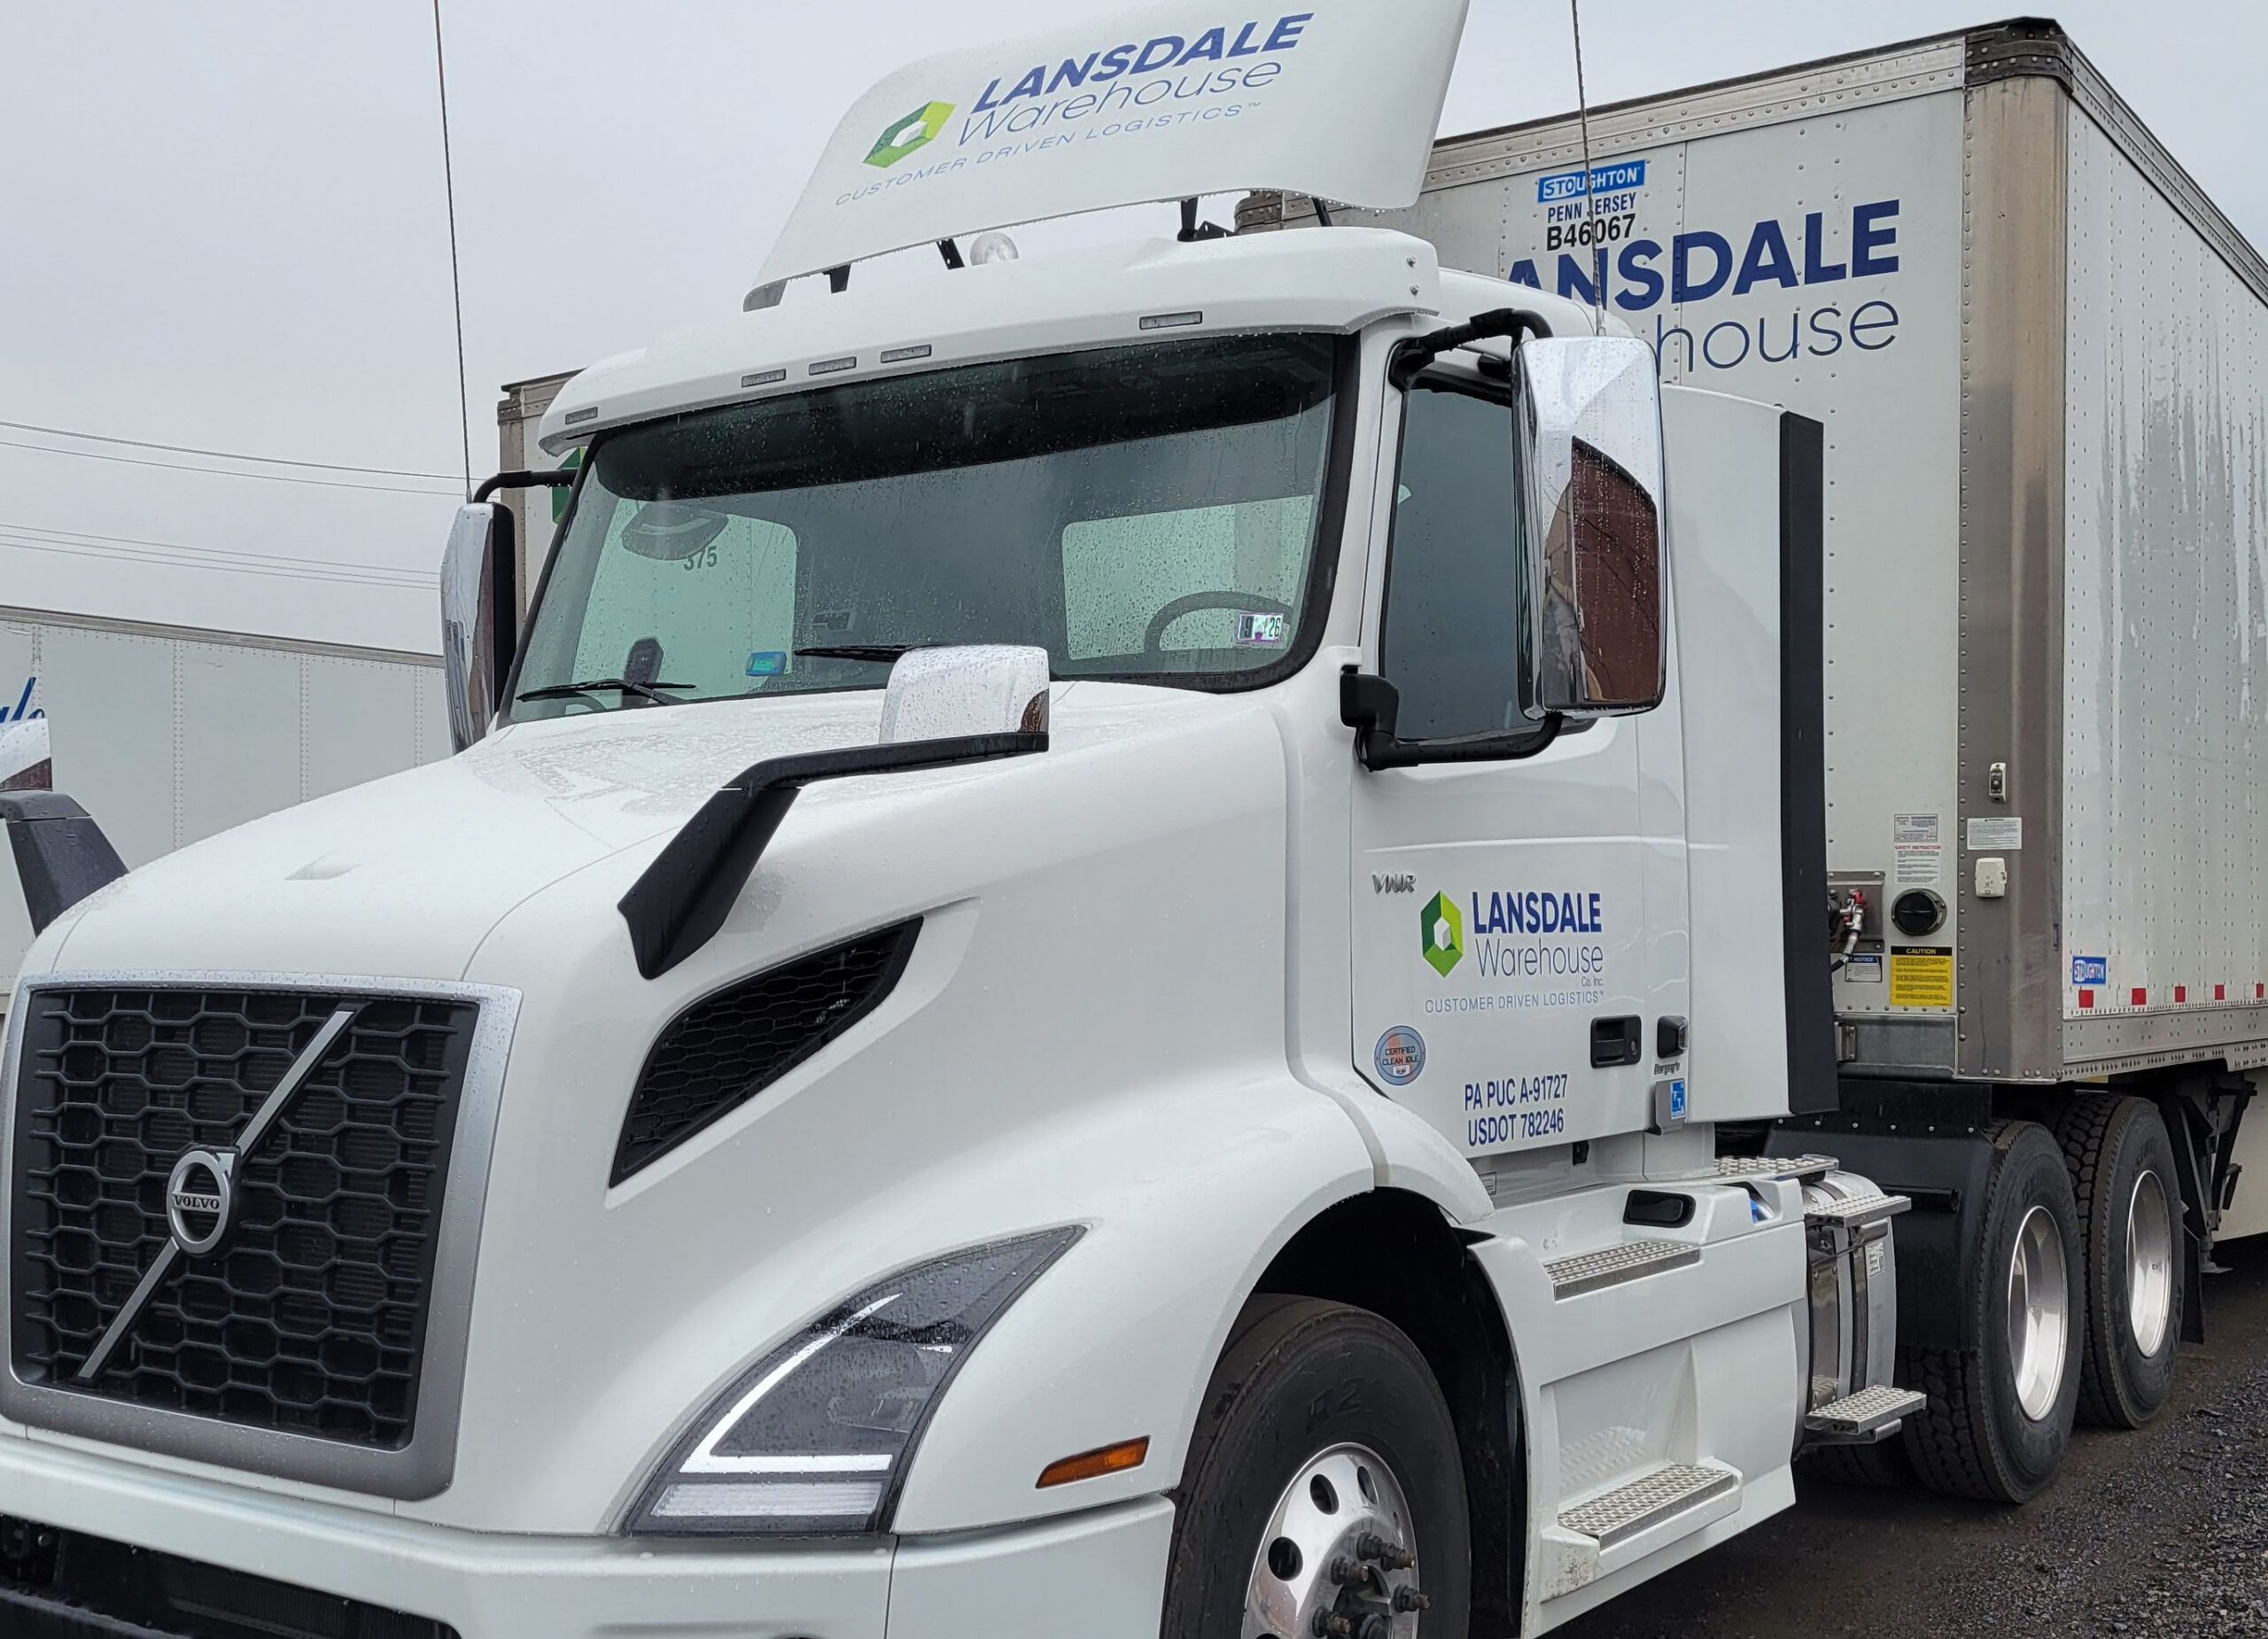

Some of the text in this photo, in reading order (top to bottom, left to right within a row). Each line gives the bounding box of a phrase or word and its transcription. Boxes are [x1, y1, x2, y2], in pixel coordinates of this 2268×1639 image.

[971, 12, 1315, 113] LANSDALE
[959, 61, 1282, 146] Warehouse
[835, 158, 967, 206] CUSTOMER
[976, 132, 1076, 165] DRIVEN
[1544, 167, 1637, 197] STOUGHTON
[1548, 192, 1636, 223] PENN ERSEY
[1547, 213, 1636, 251] B46067
[1371, 873, 1417, 894] VNR
[1472, 891, 1603, 934] LANSDALE
[1475, 936, 1604, 977] Warehouse
[1425, 997, 1494, 1013] CUSTOMER
[1498, 994, 1539, 1009] DRIVEN
[1382, 1054, 1419, 1066] CLEAN IDLE
[1385, 1046, 1416, 1056] CERTIFIED
[1464, 1073, 1568, 1111] PA PUC A-91727
[1468, 1107, 1565, 1146] USDOT 782246
[173, 1194, 220, 1209] VOLVO
